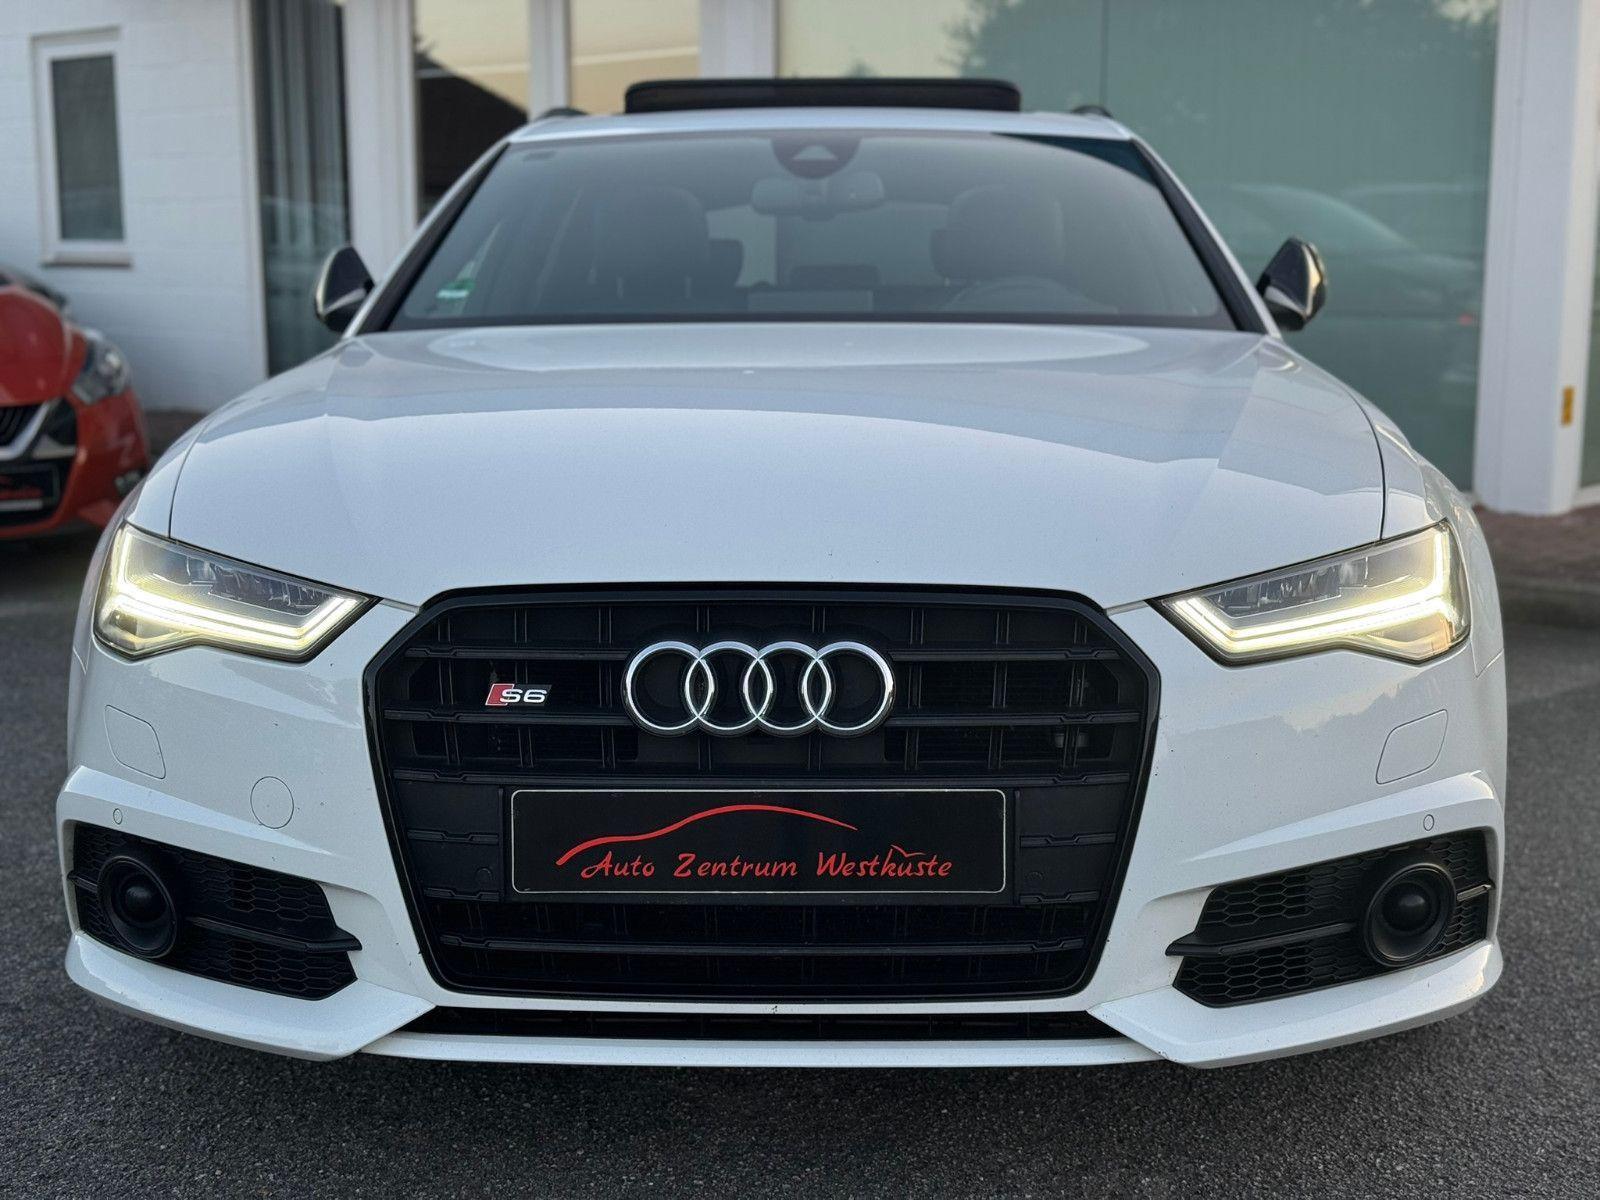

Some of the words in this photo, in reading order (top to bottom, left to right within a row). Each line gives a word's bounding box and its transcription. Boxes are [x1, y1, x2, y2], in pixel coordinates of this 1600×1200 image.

[500, 688, 548, 703] S6
[580, 850, 655, 878] Auto
[673, 852, 798, 878] Zentrum
